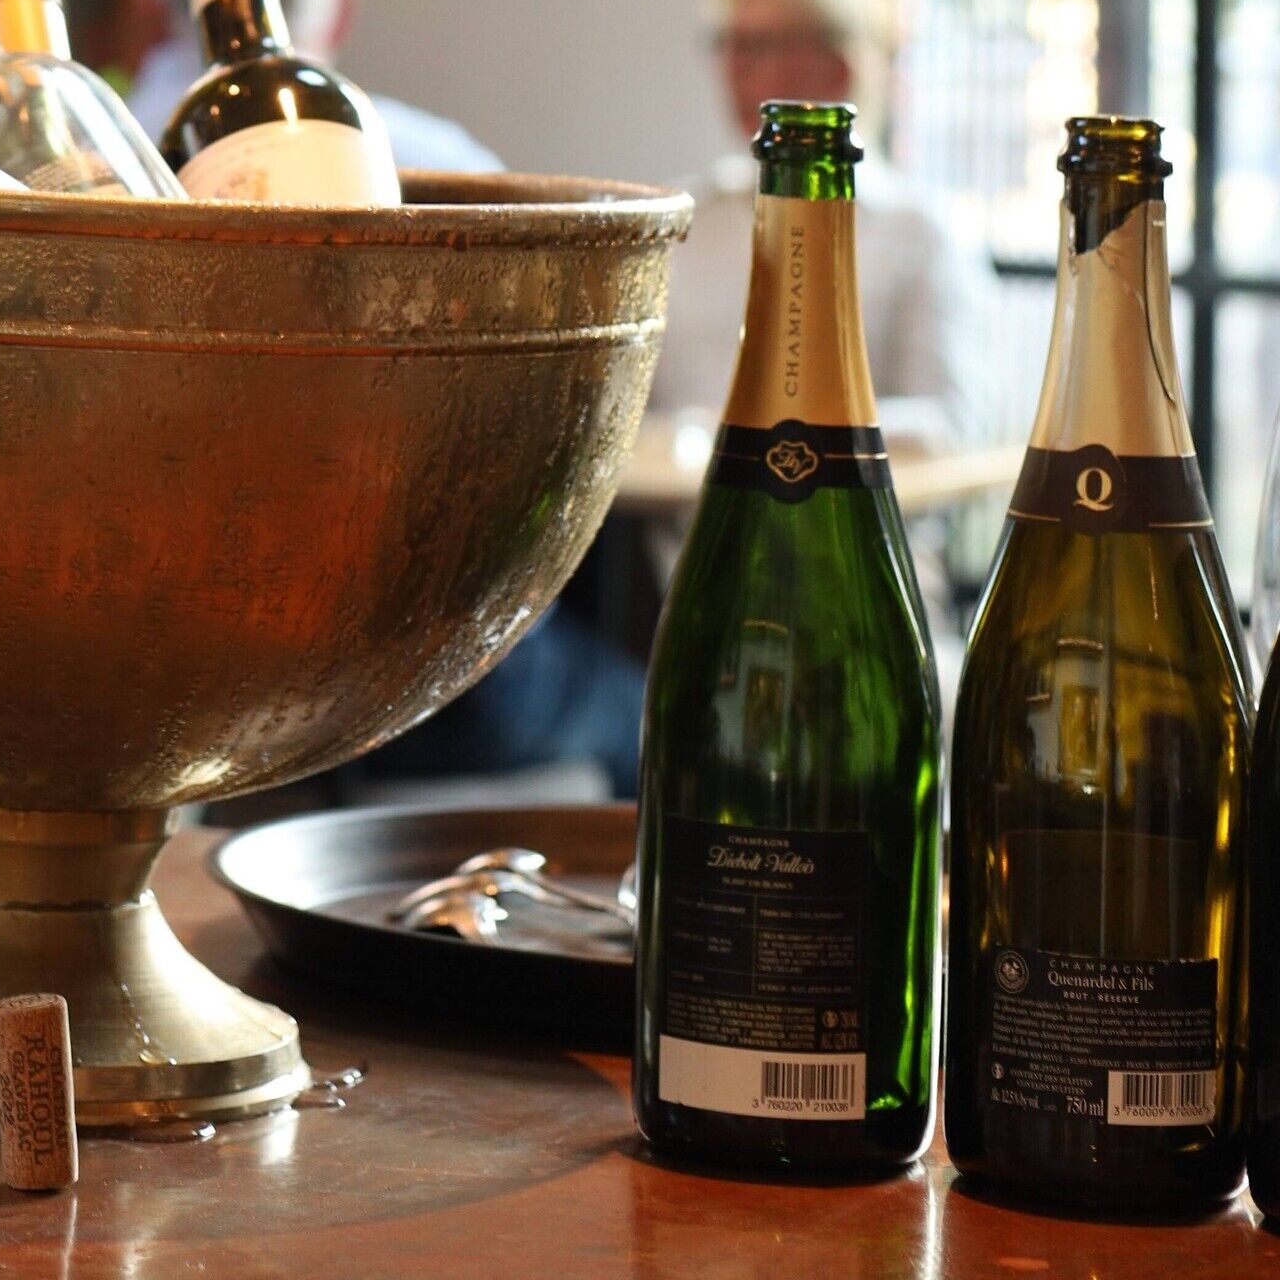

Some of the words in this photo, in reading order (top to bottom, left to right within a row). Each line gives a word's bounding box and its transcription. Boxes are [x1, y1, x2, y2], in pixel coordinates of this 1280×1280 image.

[784, 225, 805, 398] CHAMPAGNE
[1073, 467, 1114, 511] Q
[1048, 959, 1155, 976] CHAMPAGNE
[1047, 971, 1116, 990] Quenardel
[1131, 978, 1155, 991] Fils
[1063, 991, 1089, 1001] BRUT
[0, 1071, 16, 1127] 2022
[12, 1050, 30, 1122] GRAVES
[24, 1033, 54, 1166] RAHOUL
[751, 1098, 759, 1109] 3
[766, 1099, 803, 1112] 760220
[813, 1101, 849, 1113] 210036
[1066, 1094, 1087, 1116] 750
[1089, 1098, 1105, 1118] ml
[1112, 1105, 1121, 1117] 3
[18, 1124, 33, 1153] AC
